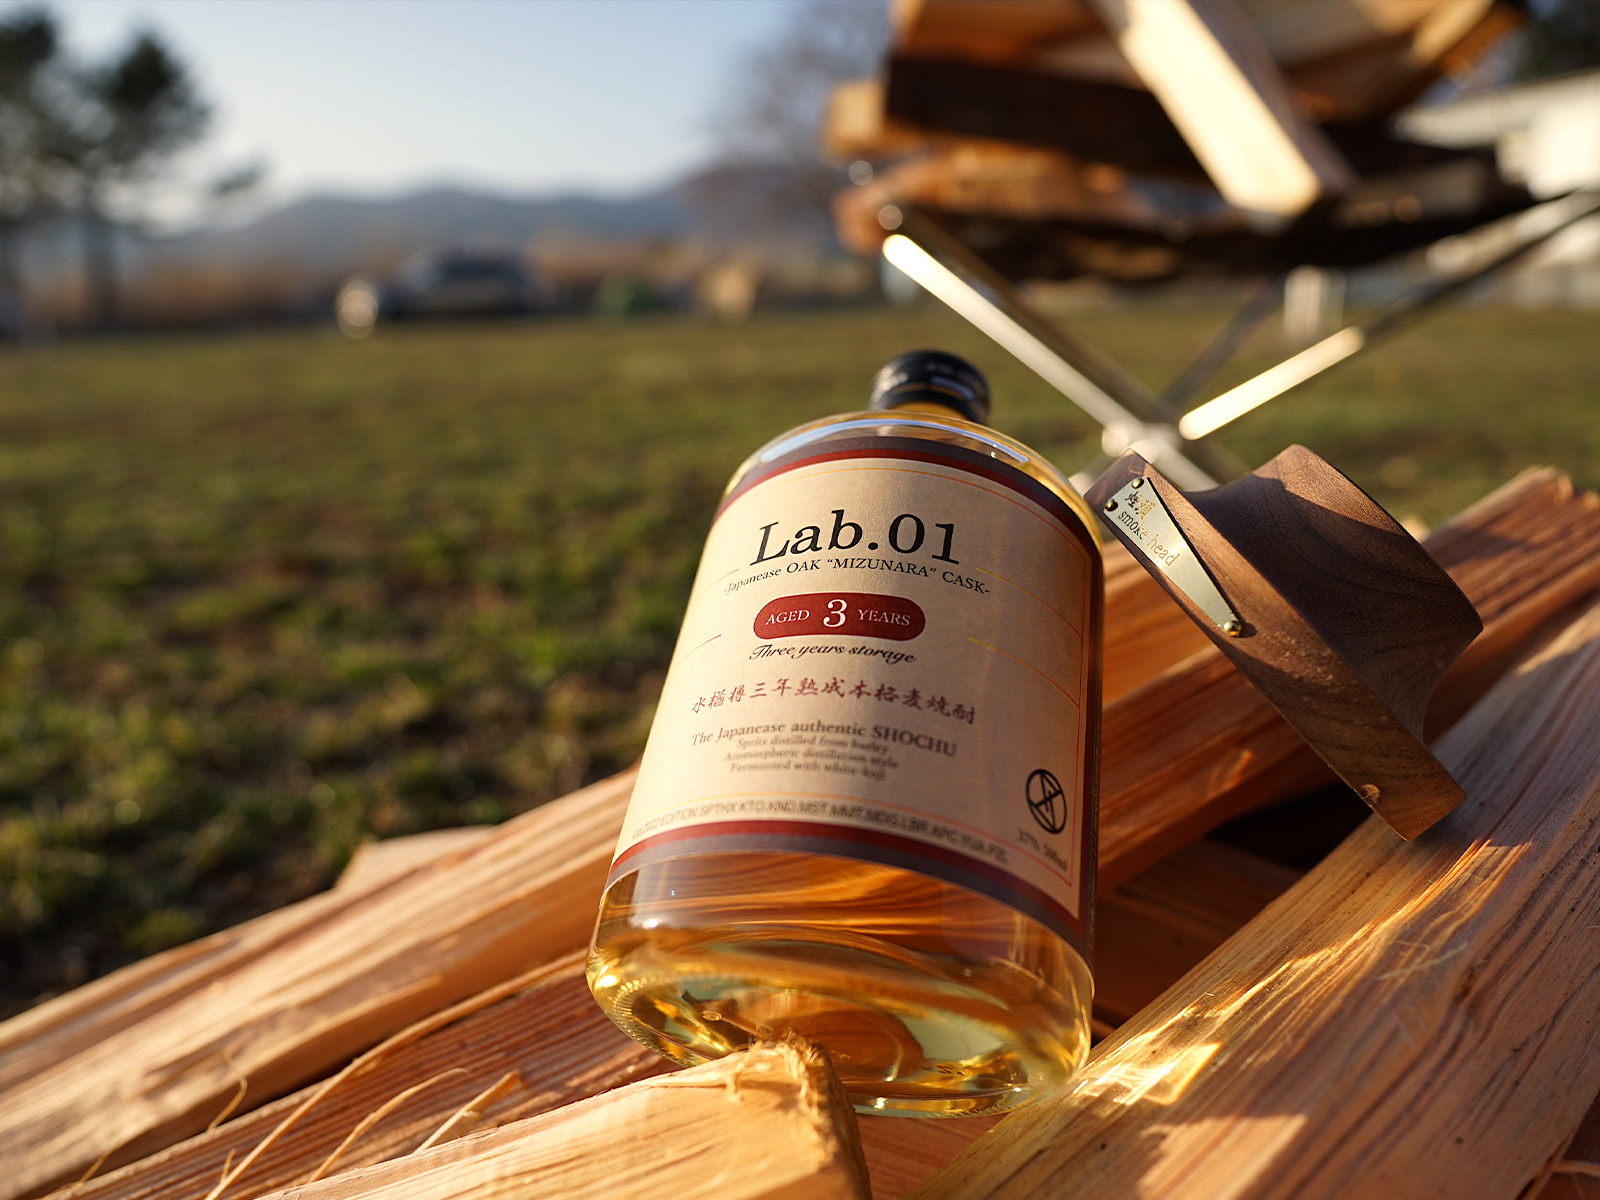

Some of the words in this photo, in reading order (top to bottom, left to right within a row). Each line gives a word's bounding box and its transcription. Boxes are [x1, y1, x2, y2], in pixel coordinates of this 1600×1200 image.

[750, 508, 960, 567] Lab.01
[1118, 511, 1149, 540] smoke
[1146, 533, 1180, 566] head
[786, 559, 821, 574] OAK
[765, 609, 810, 626] AGED
[822, 598, 848, 628] 3
[857, 608, 911, 627] YEARS
[749, 644, 796, 661] Three
[791, 645, 845, 660] years
[848, 645, 917, 666] storage
[692, 732, 714, 747] The
[790, 719, 867, 738] authentic
[871, 724, 958, 758] SHOCHU
